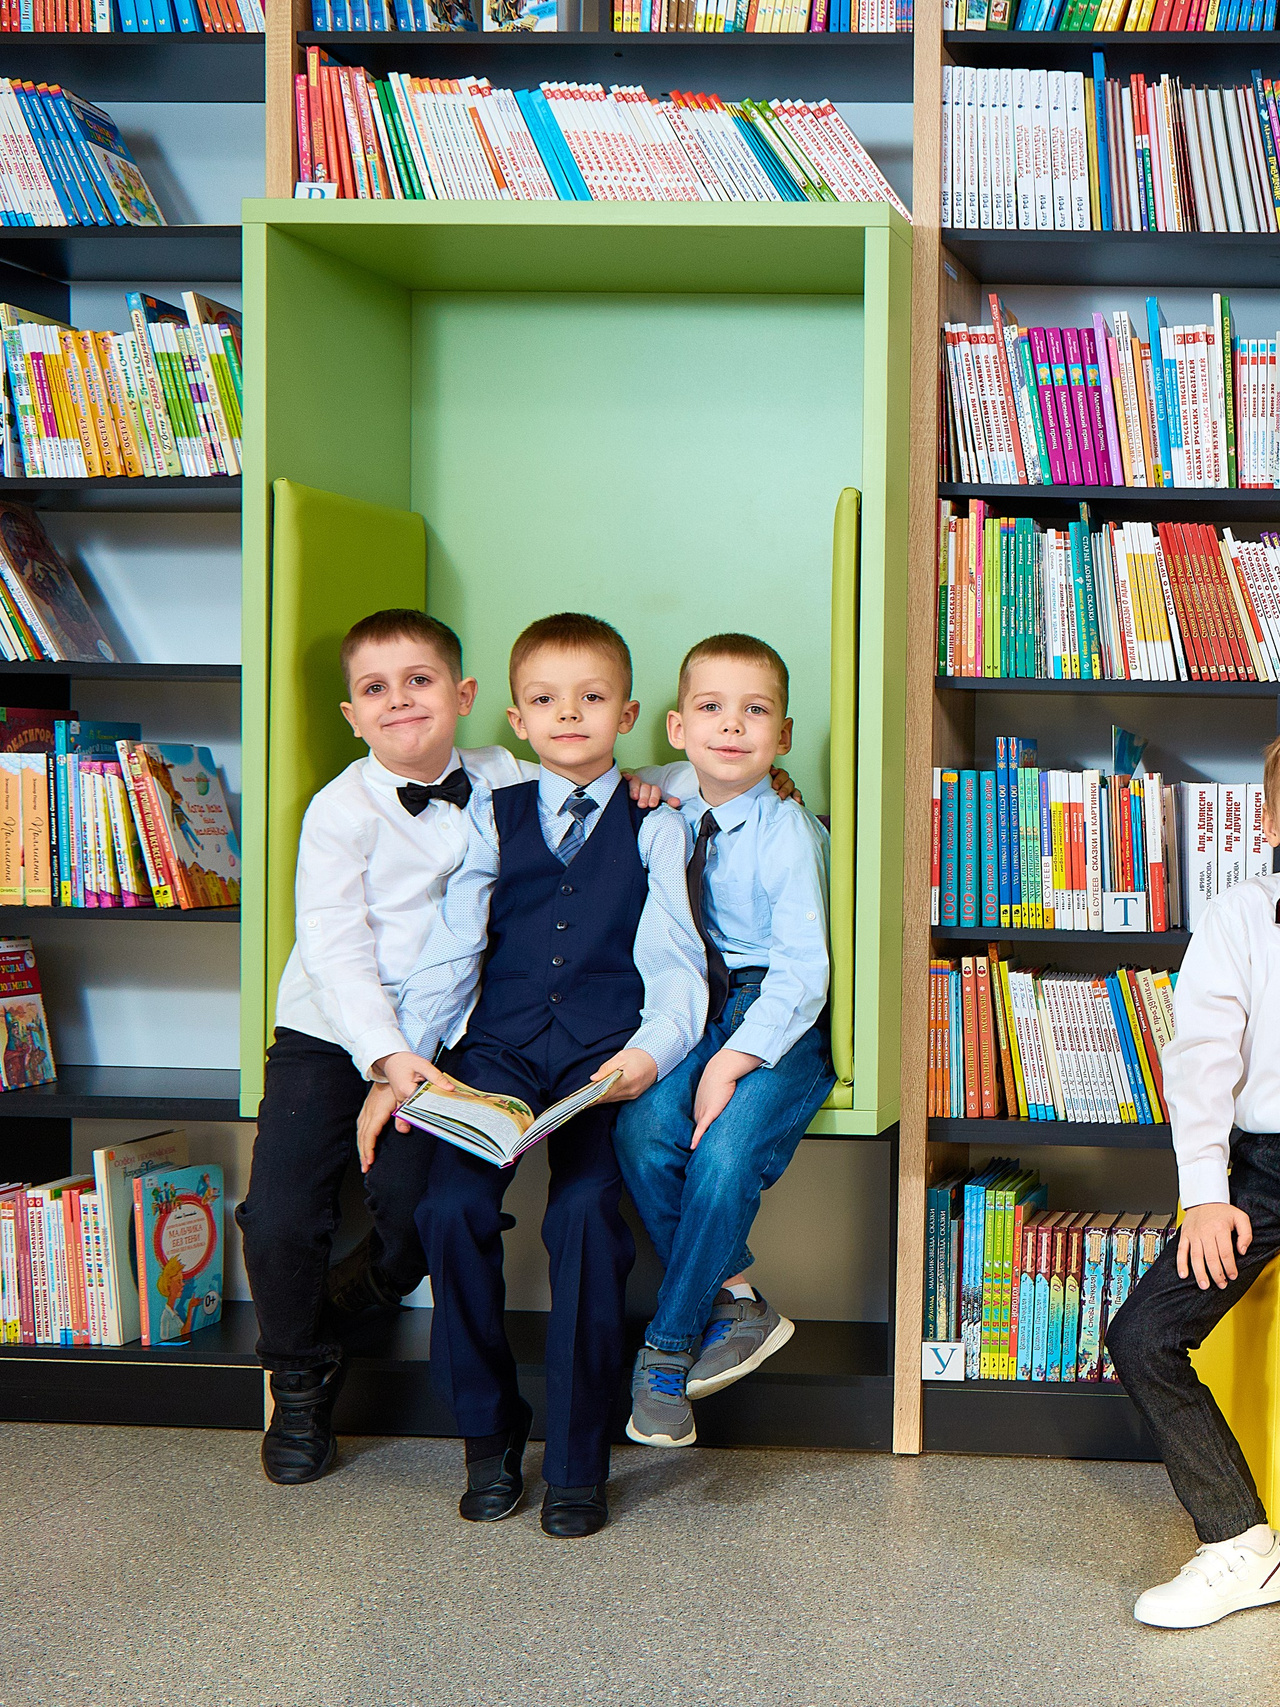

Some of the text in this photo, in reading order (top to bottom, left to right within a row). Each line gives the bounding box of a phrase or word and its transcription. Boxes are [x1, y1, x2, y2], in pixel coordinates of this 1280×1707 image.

[1154, 367, 1166, 421] Сивка-бурка
[144, 409, 155, 431] СОВЕТЫ
[1077, 391, 1089, 450] Маленький принц
[1093, 392, 1105, 451] Маленький принц
[1187, 359, 1203, 480] СКАЗКИ РУССКИХ ПИСАТЕЛЕЙ
[1083, 536, 1091, 561] СТАРЫЕ
[1084, 564, 1092, 591] ДОБРЫЕ
[948, 585, 956, 625] РАССКАЗЫ
[1163, 589, 1174, 616] СТИХИ
[964, 778, 973, 800] ВОЙНЕ
[965, 812, 973, 850] РАССКАЗОВ
[1198, 832, 1206, 852] Аля,
[1090, 838, 1098, 871] СКАЗКИ
[965, 864, 973, 891] СТИХОВ
[963, 893, 975, 921] 100
[1114, 898, 1138, 926] Т
[965, 994, 975, 1088] МАЛЕНЬКИЕ РАССКАЗЫ
[168, 1224, 203, 1238] МАЛЬЧИКА
[171, 1235, 201, 1248] БЕЗ ТЕНИ
[930, 1348, 957, 1375] У
